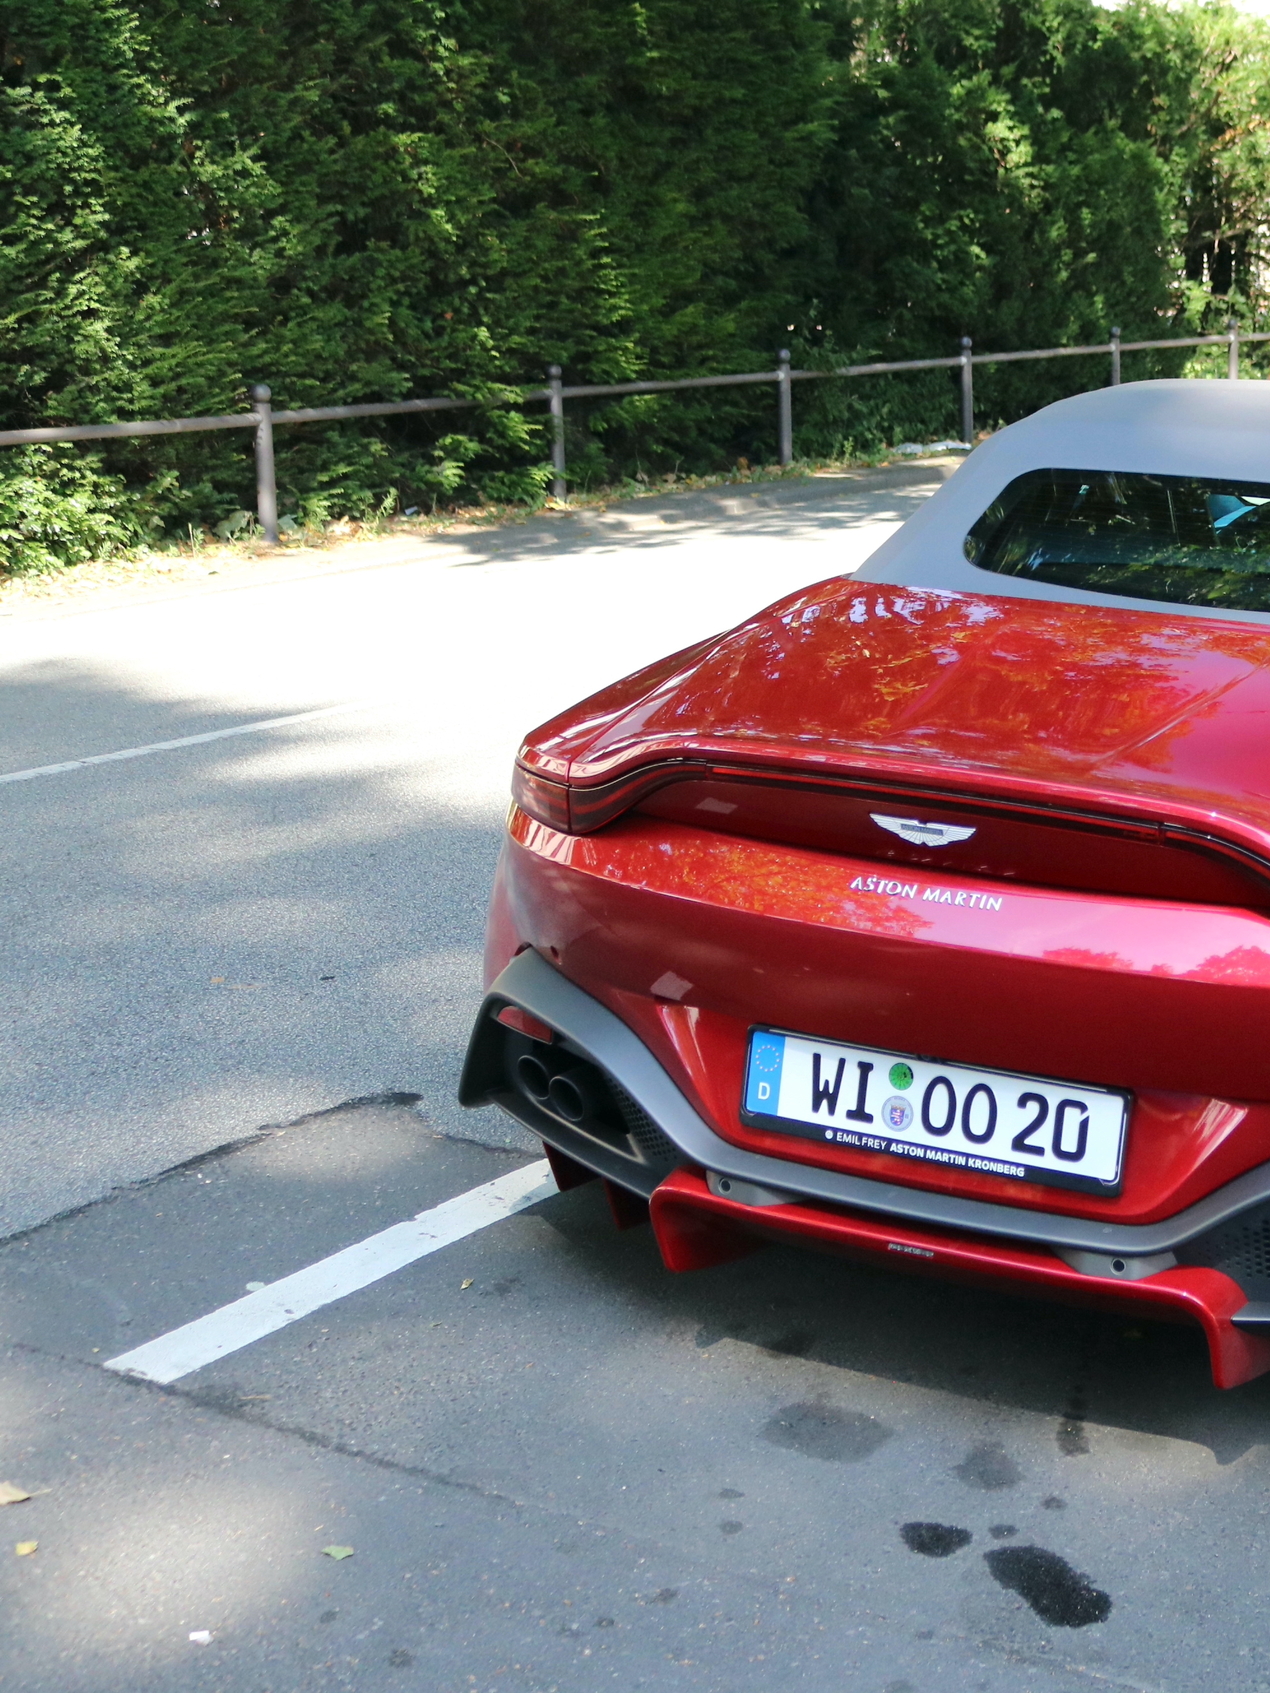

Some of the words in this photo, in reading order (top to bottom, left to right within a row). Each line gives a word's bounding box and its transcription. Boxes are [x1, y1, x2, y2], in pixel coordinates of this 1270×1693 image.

[850, 876, 918, 899] ASTON
[922, 887, 1003, 912] MARTIN
[757, 1082, 771, 1100] D
[811, 1053, 874, 1124] WI
[1011, 1092, 1090, 1163] 20
[836, 1132, 860, 1145] EMIL
[861, 1137, 887, 1150] FREY
[889, 1142, 925, 1158] ASTON
[925, 1149, 966, 1166] MARTIN
[967, 1157, 1025, 1177] KRONBERG
